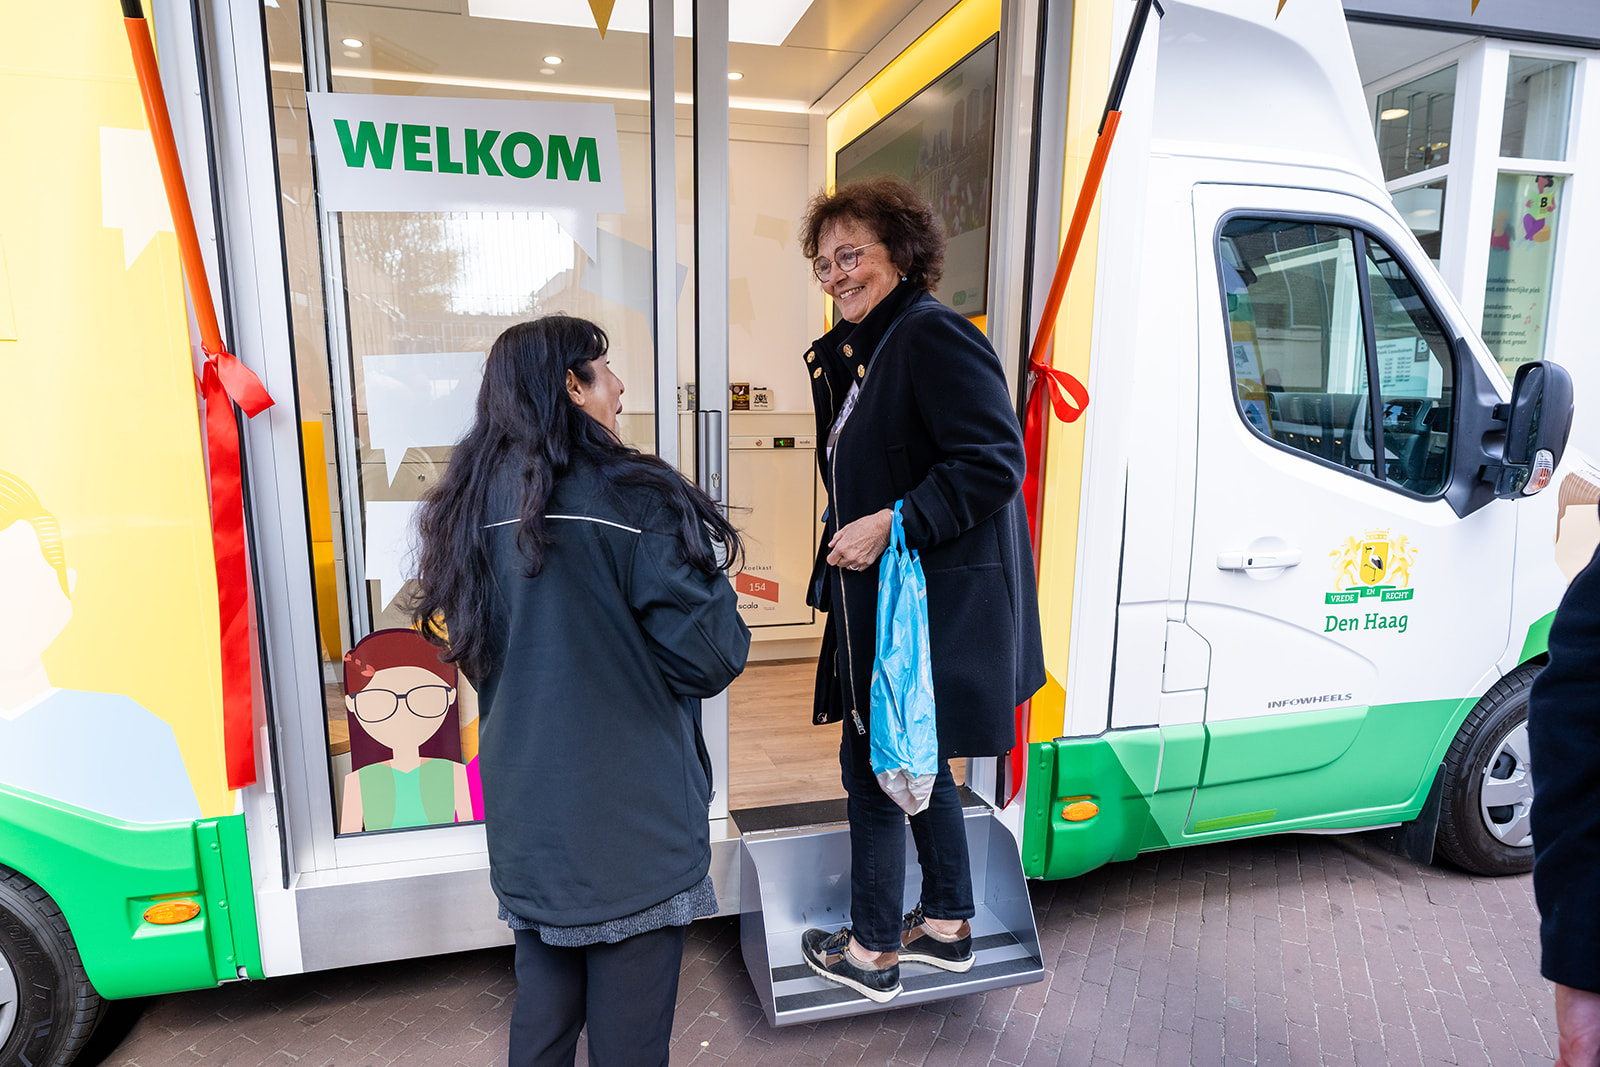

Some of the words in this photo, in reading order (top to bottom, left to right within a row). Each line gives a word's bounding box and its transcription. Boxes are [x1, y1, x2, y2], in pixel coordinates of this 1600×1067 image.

[333, 118, 602, 182] WELKOM
[1540, 197, 1548, 208] B
[750, 582, 766, 592] 154
[1330, 594, 1355, 602] VREDE
[1385, 591, 1409, 600] RECHT
[738, 601, 758, 609] scala
[1324, 615, 1359, 633] Den
[1363, 613, 1408, 633] Haag
[1268, 693, 1353, 708] INFOWHEELS
